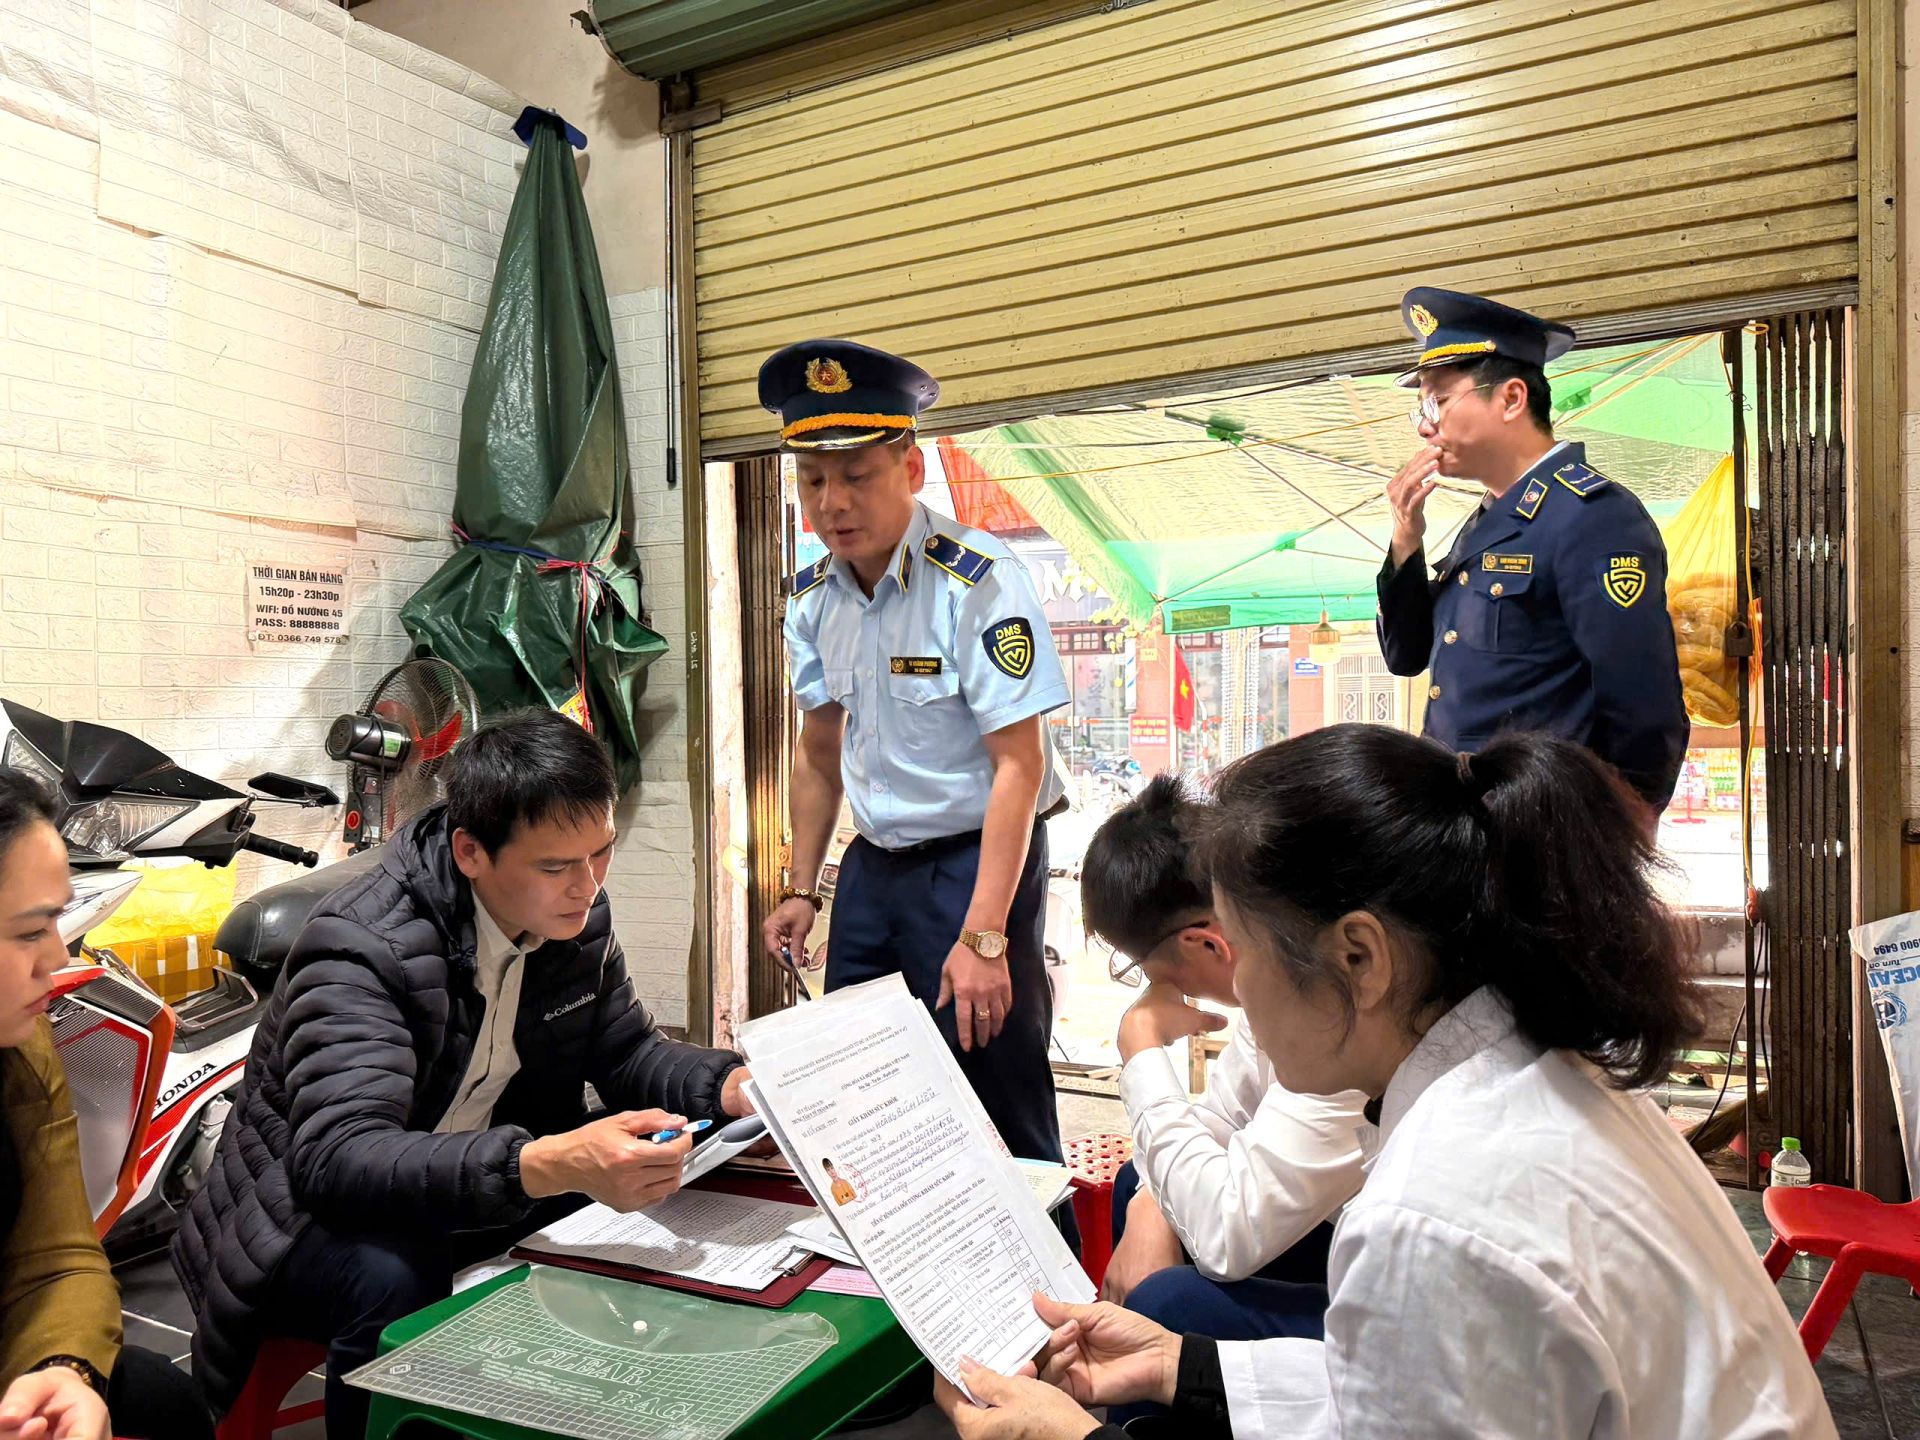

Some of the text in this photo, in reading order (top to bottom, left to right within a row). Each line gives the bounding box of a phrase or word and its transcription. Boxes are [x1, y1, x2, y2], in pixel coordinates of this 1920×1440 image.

[1610, 557, 1639, 568] DMS
[276, 568, 297, 580] GIAN
[300, 569, 317, 582] BÁN
[259, 586, 294, 598] 15h20p
[304, 590, 339, 602] 23h30p
[256, 604, 279, 613] WIFI:
[332, 609, 343, 617] 45
[255, 618, 340, 630] PASS: 88888888
[995, 624, 1021, 640] DMS
[278, 635, 301, 643] 0366
[304, 636, 321, 644] 749
[325, 637, 340, 645] 578
[1873, 938, 1920, 955] 900 6494
[1882, 959, 1901, 967] Turn
[554, 993, 596, 1016] Columbia
[469, 1336, 528, 1359] My
[527, 1349, 651, 1386] CLEAR
[601, 1390, 695, 1420] BAG
